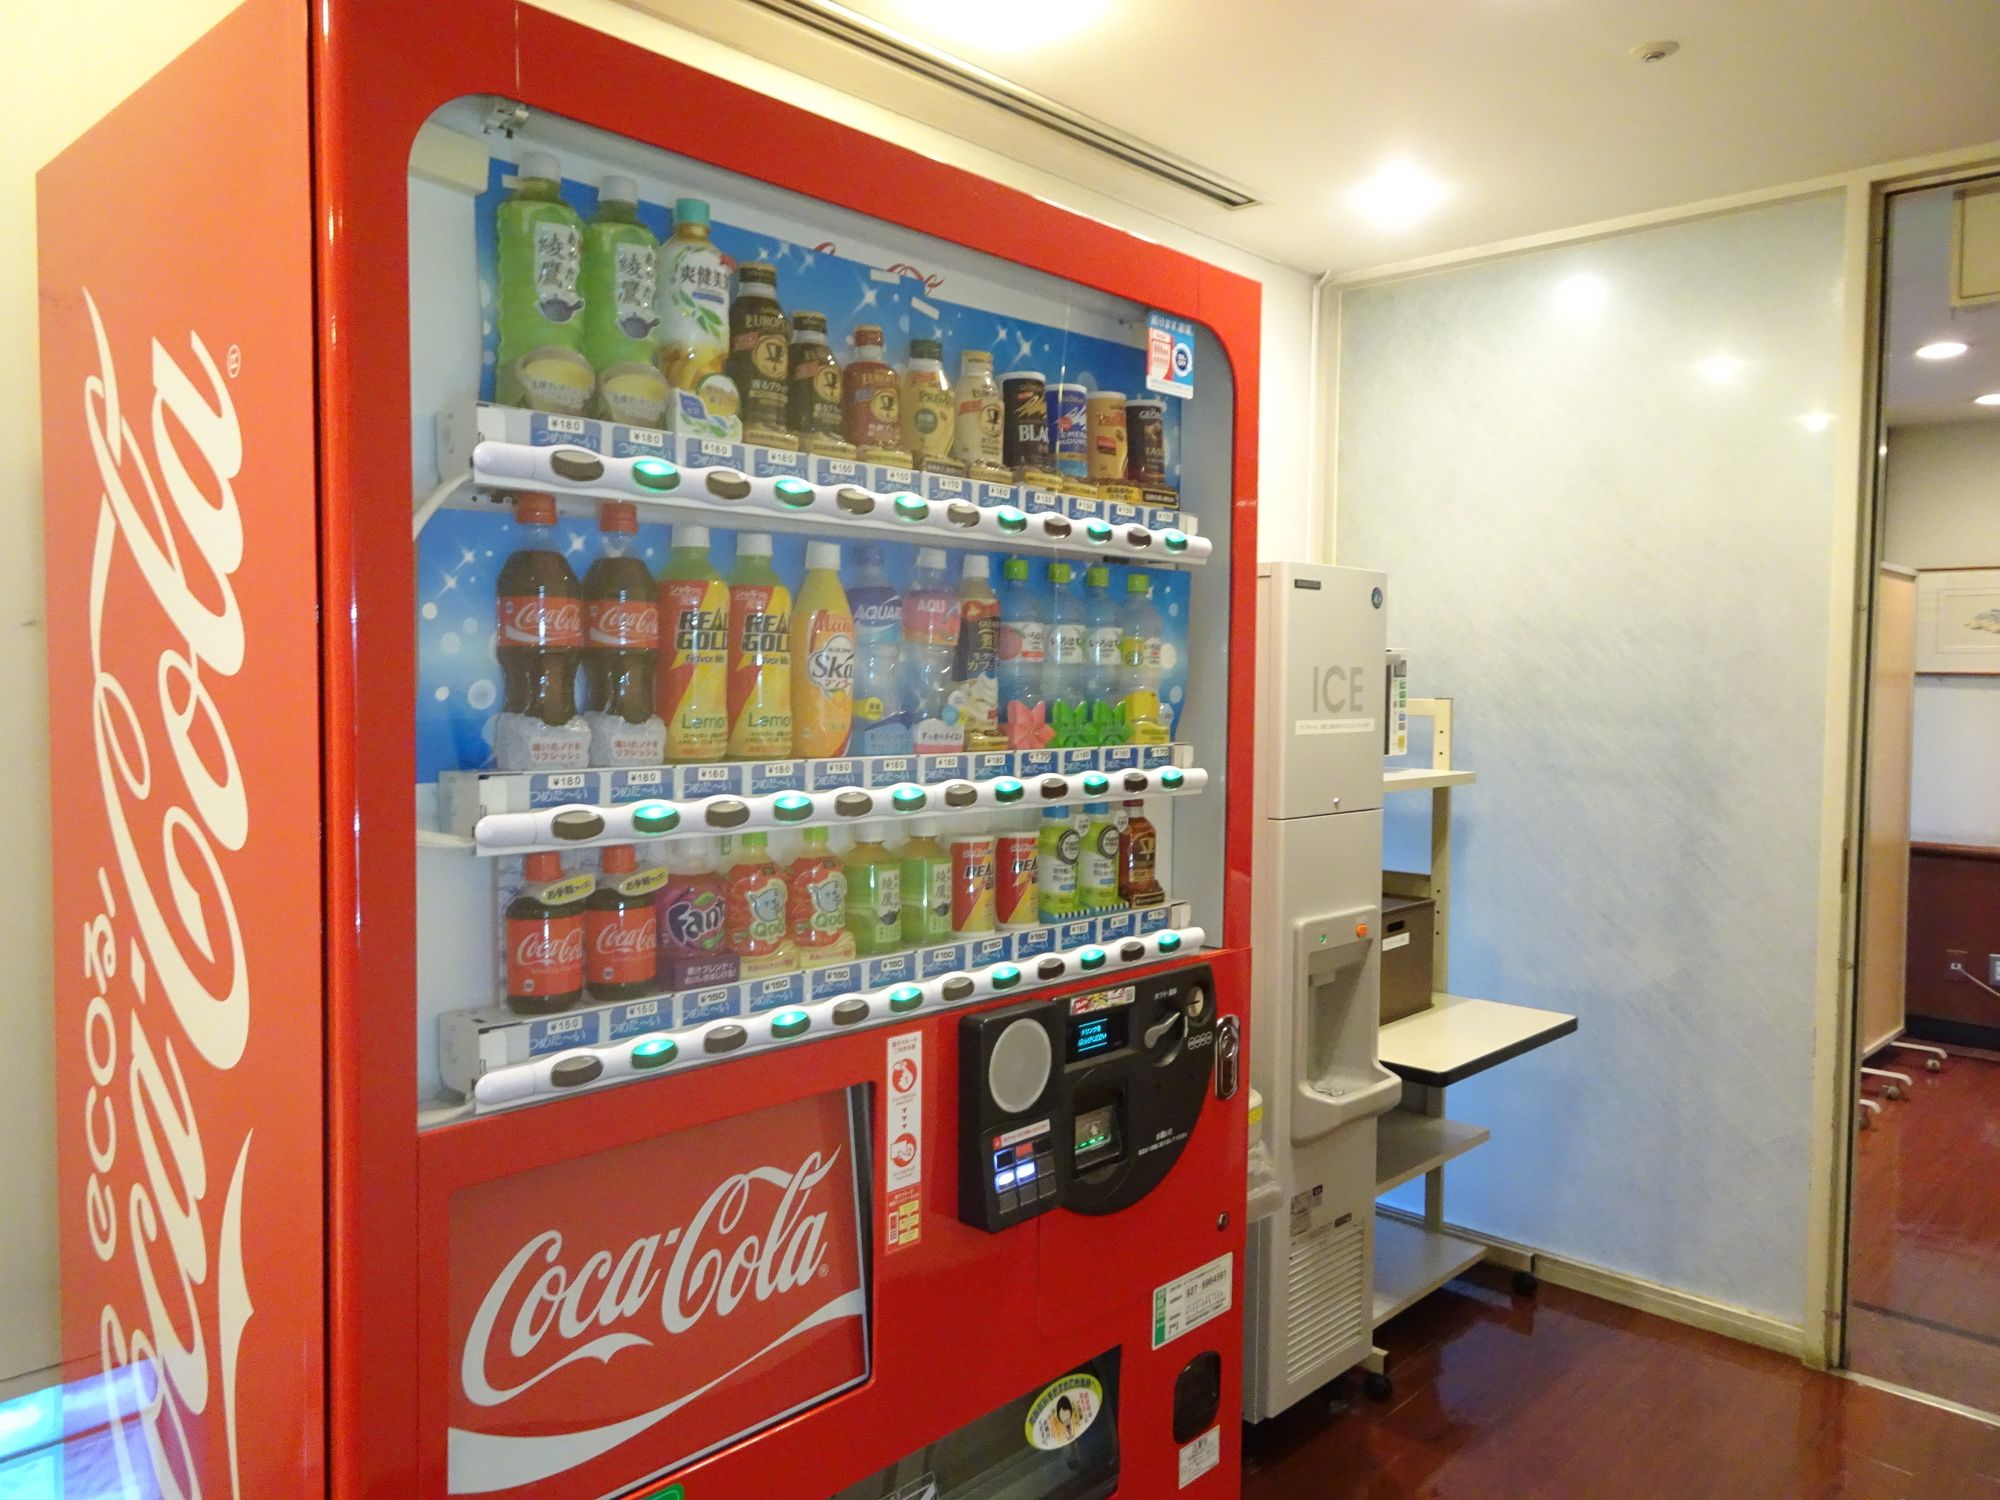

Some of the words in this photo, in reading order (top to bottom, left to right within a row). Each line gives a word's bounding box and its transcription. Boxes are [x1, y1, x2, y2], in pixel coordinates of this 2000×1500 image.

[681, 263, 729, 291] 爽健美
[552, 418, 580, 431] ¥180
[634, 432, 660, 444] ¥180
[704, 443, 728, 454] ¥180
[771, 452, 794, 462] ¥180
[1312, 665, 1363, 714] ICE
[682, 712, 726, 729] Lemo
[748, 711, 791, 728] Lemo
[768, 765, 790, 774] ¥180
[829, 762, 849, 771] ¥180
[631, 771, 656, 781] ¥180
[701, 768, 725, 777] ¥180
[553, 777, 580, 786] ¥180
[667, 897, 725, 945] Fant
[935, 951, 954, 961] ¥150
[883, 960, 903, 970] ¥150
[827, 970, 849, 981] ¥150
[765, 980, 787, 991] ¥150
[701, 992, 725, 1002] ¥150
[629, 1004, 654, 1015] ¥150
[551, 1020, 579, 1031] ¥150
[461, 1143, 842, 1408] Coca-Cola
